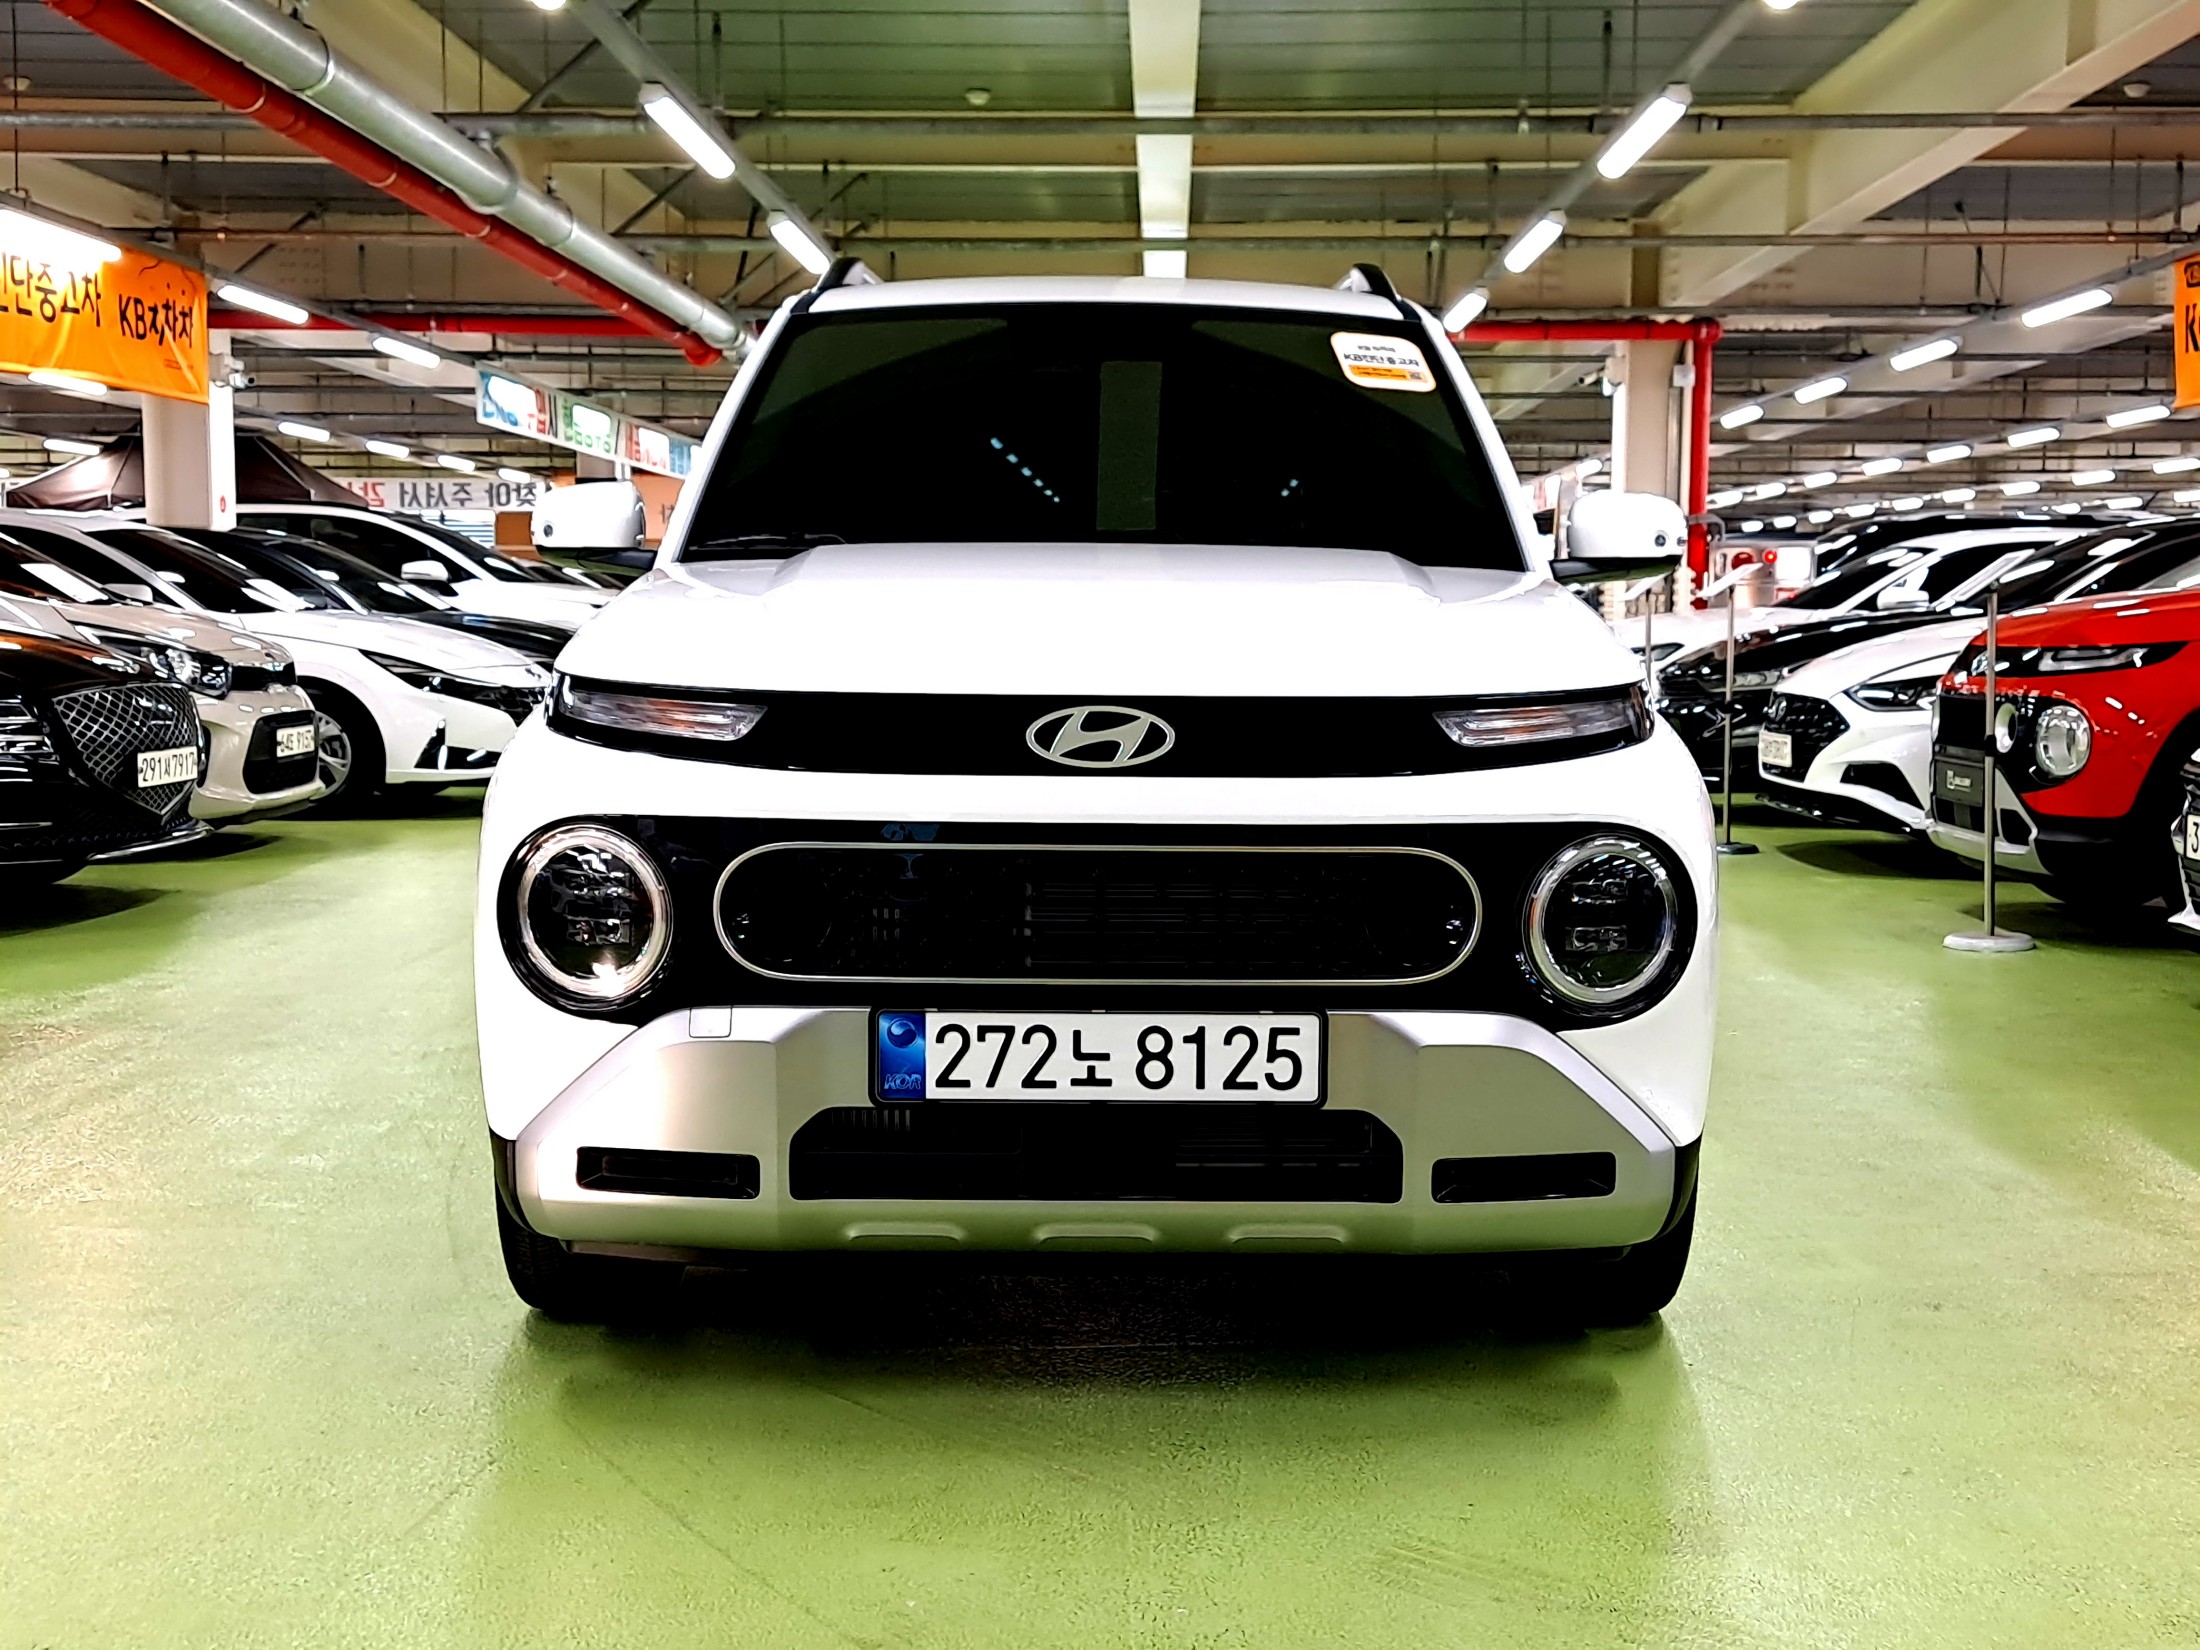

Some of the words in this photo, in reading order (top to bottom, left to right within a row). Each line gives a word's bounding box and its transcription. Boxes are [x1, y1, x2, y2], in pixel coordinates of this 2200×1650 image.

[935, 1024, 1112, 1089] 272노
[1135, 1025, 1303, 1091] 8125
[884, 1073, 922, 1090] KOR
